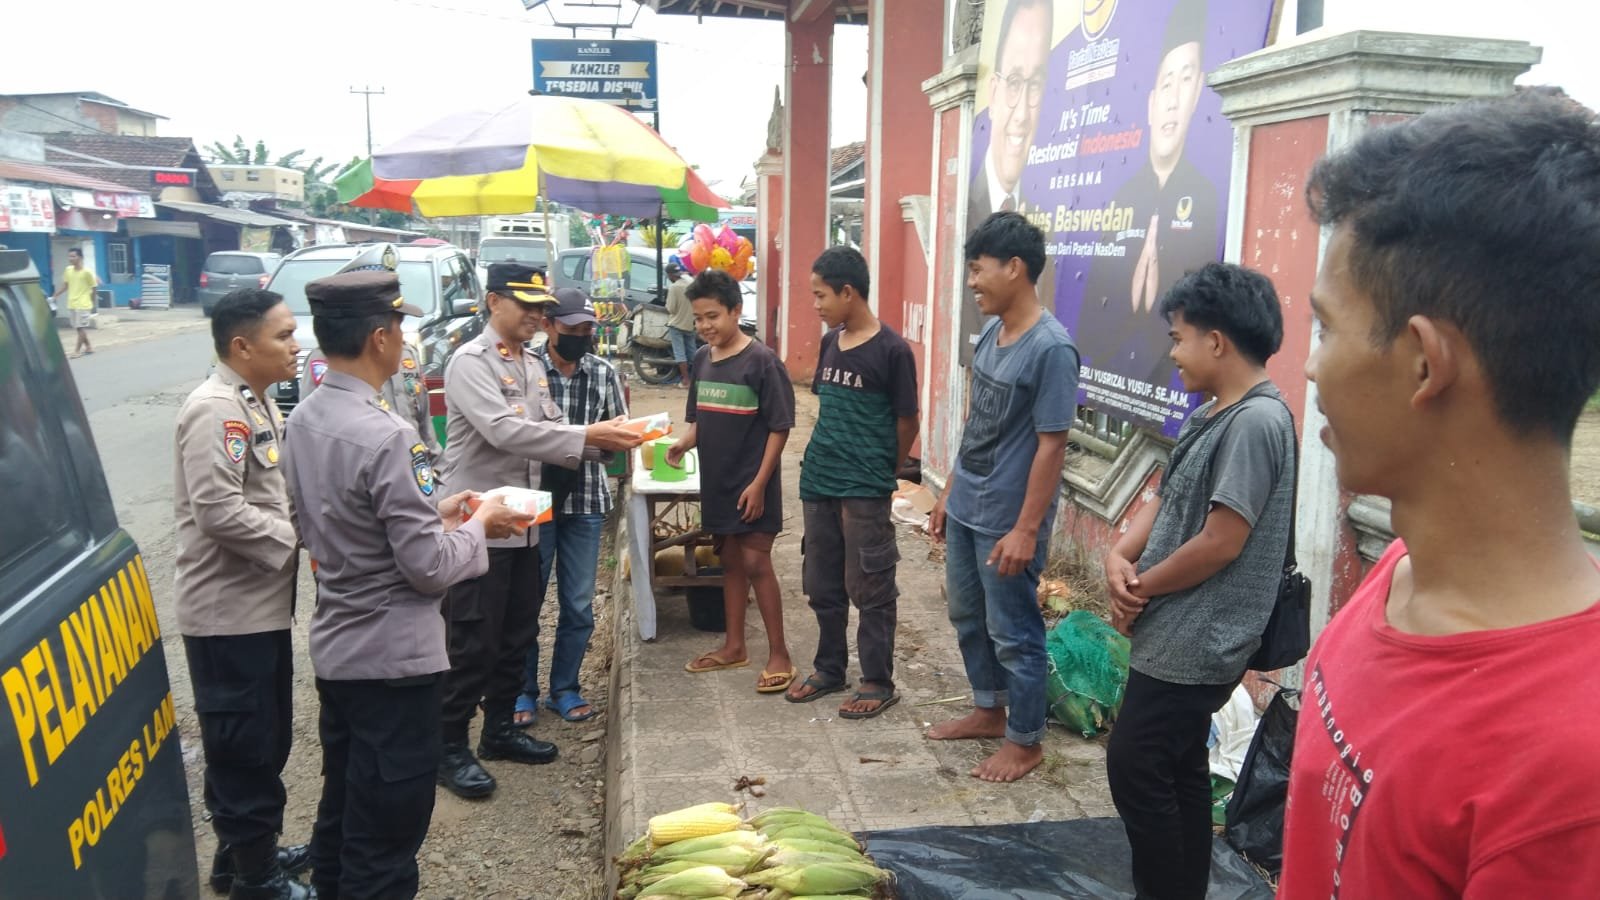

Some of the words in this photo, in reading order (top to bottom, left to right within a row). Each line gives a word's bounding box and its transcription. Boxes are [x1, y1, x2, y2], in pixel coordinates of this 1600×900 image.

[569, 63, 621, 76] KANZLER
[545, 80, 599, 93] TERSEDIA
[1058, 108, 1079, 133] It's
[1079, 101, 1112, 127] Time
[1027, 134, 1080, 166] Restorasi
[1080, 123, 1143, 157] Indonesia
[1049, 171, 1102, 190] BERSAMA
[1054, 200, 1135, 233] Baswedan
[1057, 240, 1072, 256] Dari
[1072, 241, 1093, 258] Partai
[1093, 242, 1127, 257] NasDem
[821, 367, 864, 389] OSAKA
[1093, 368, 1126, 391] YUSRIZAL
[0, 553, 161, 789] PELAYANAN
[67, 738, 145, 871] POLRES
